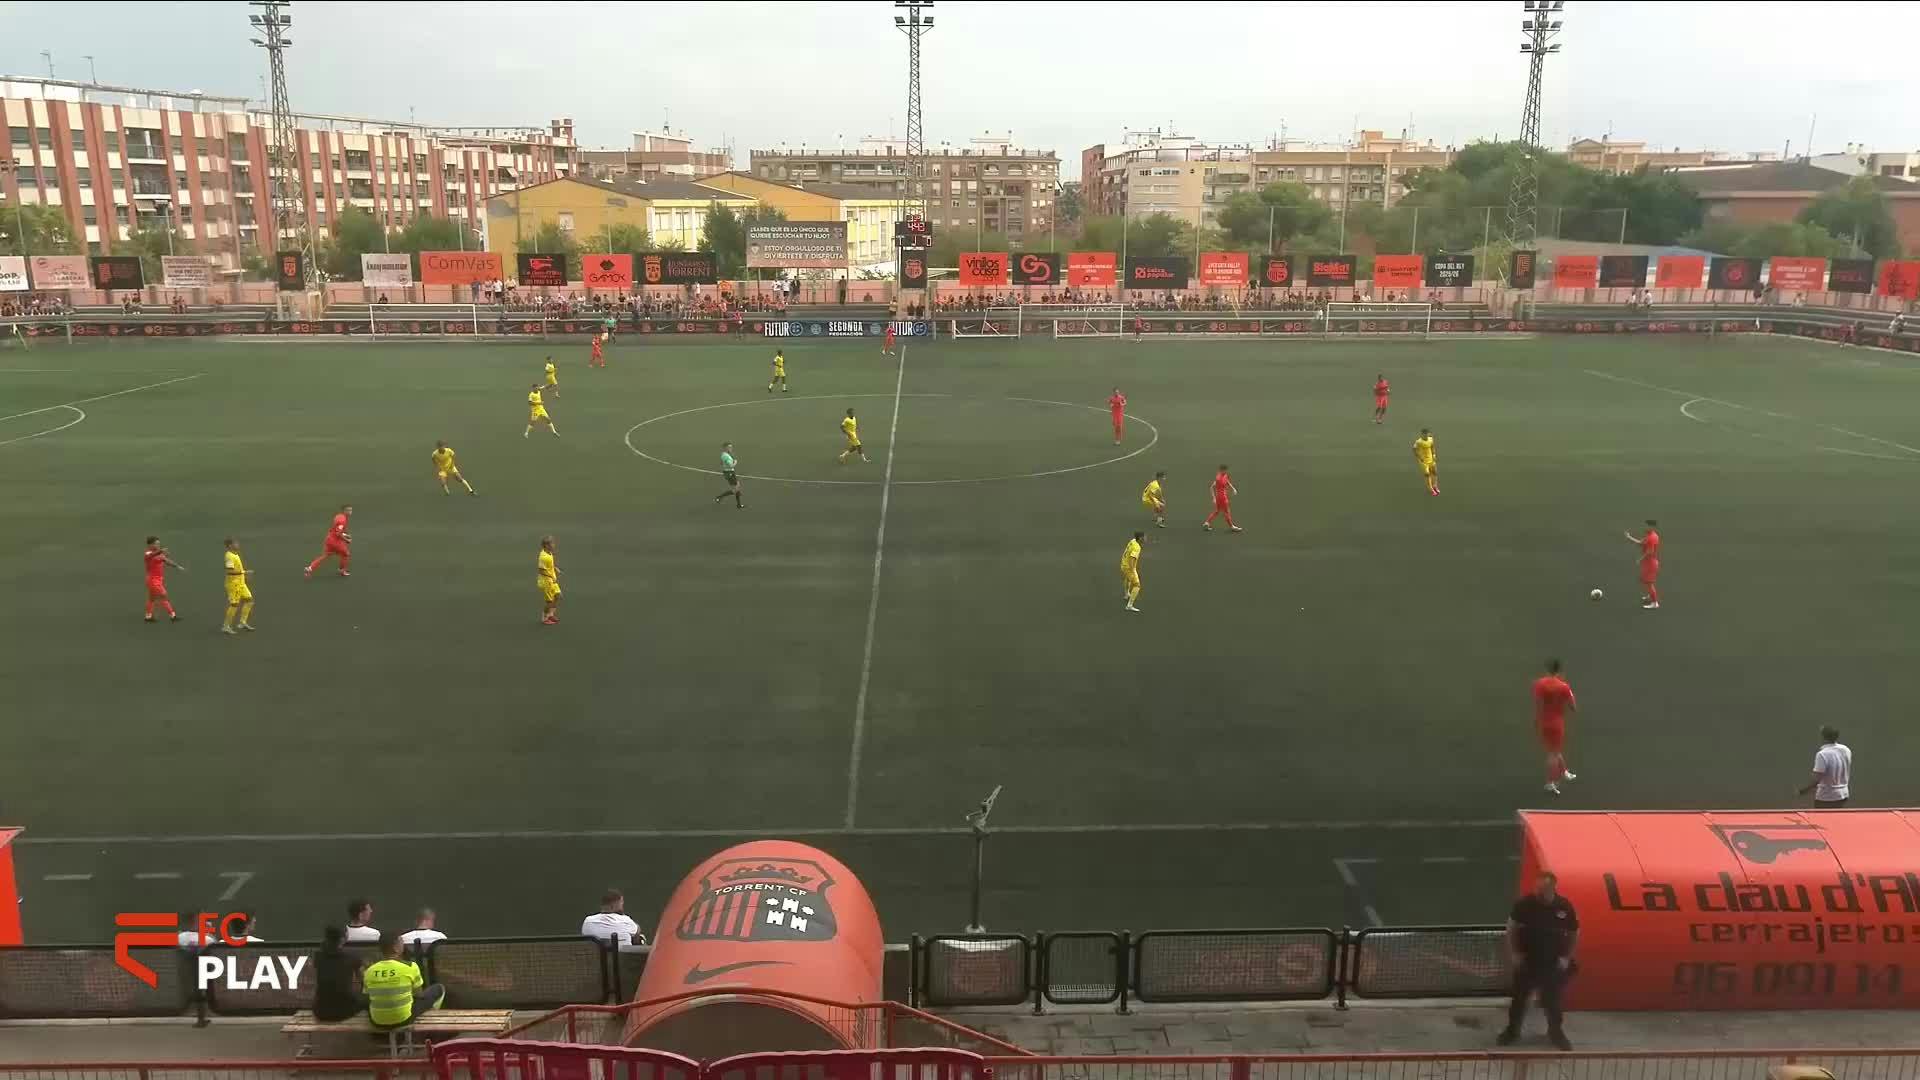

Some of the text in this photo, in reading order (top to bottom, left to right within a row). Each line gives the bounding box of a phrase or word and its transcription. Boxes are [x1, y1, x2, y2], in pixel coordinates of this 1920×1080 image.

[428, 255, 495, 270] ComVas
[829, 322, 863, 331] SEGUNDA
[714, 883, 785, 896] TORRENT
[1602, 872, 1681, 912] La
[1693, 871, 1812, 912] clau
[374, 969, 396, 977] TES
[1673, 961, 1739, 995] 96
